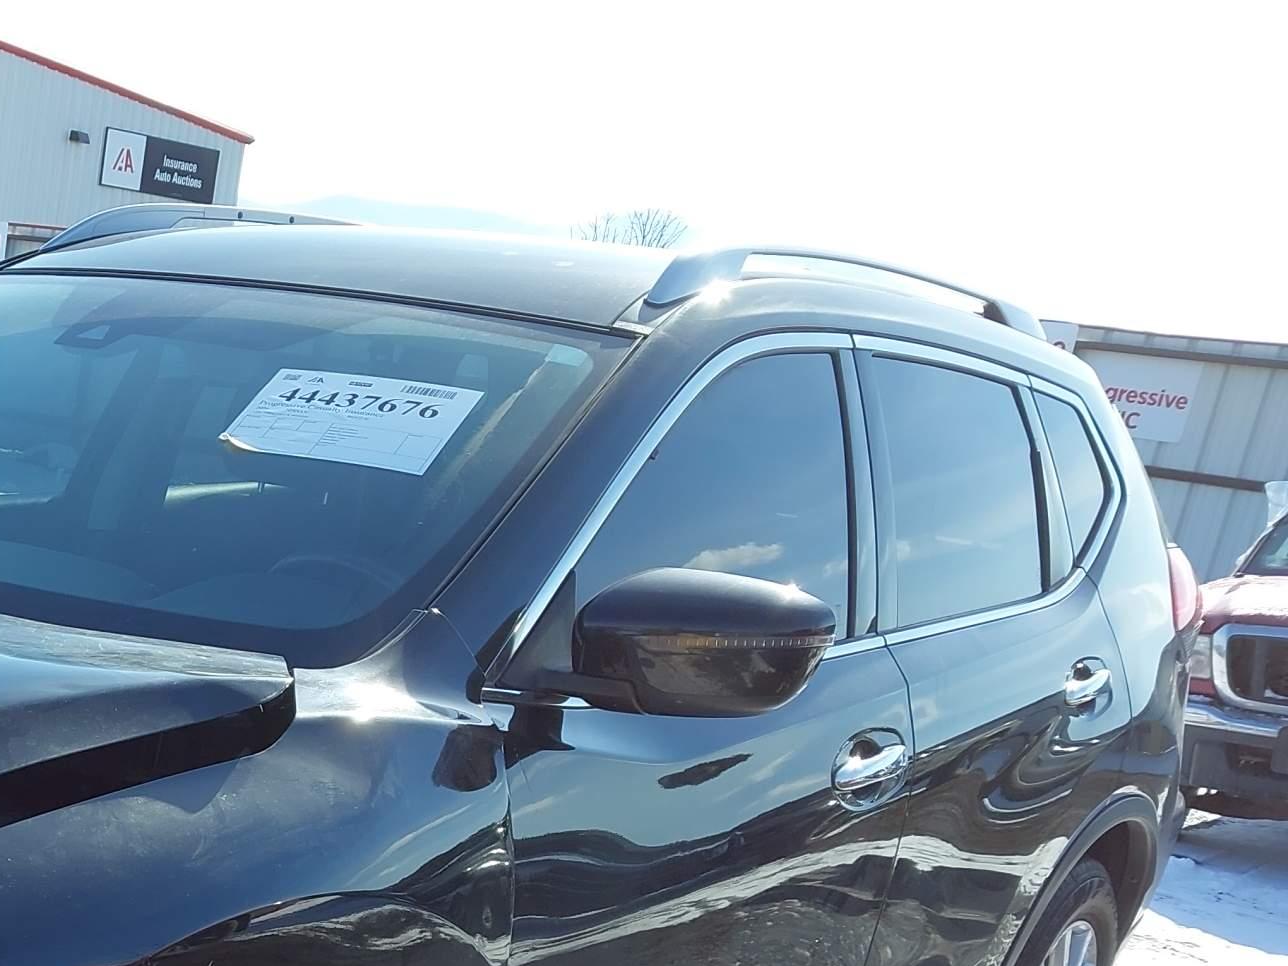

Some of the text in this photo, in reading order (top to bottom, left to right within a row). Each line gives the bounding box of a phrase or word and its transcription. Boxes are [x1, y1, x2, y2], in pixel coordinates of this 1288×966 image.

[163, 154, 198, 173] Insurance
[154, 168, 202, 189] Auto Auctions
[278, 388, 443, 418] 44437676
